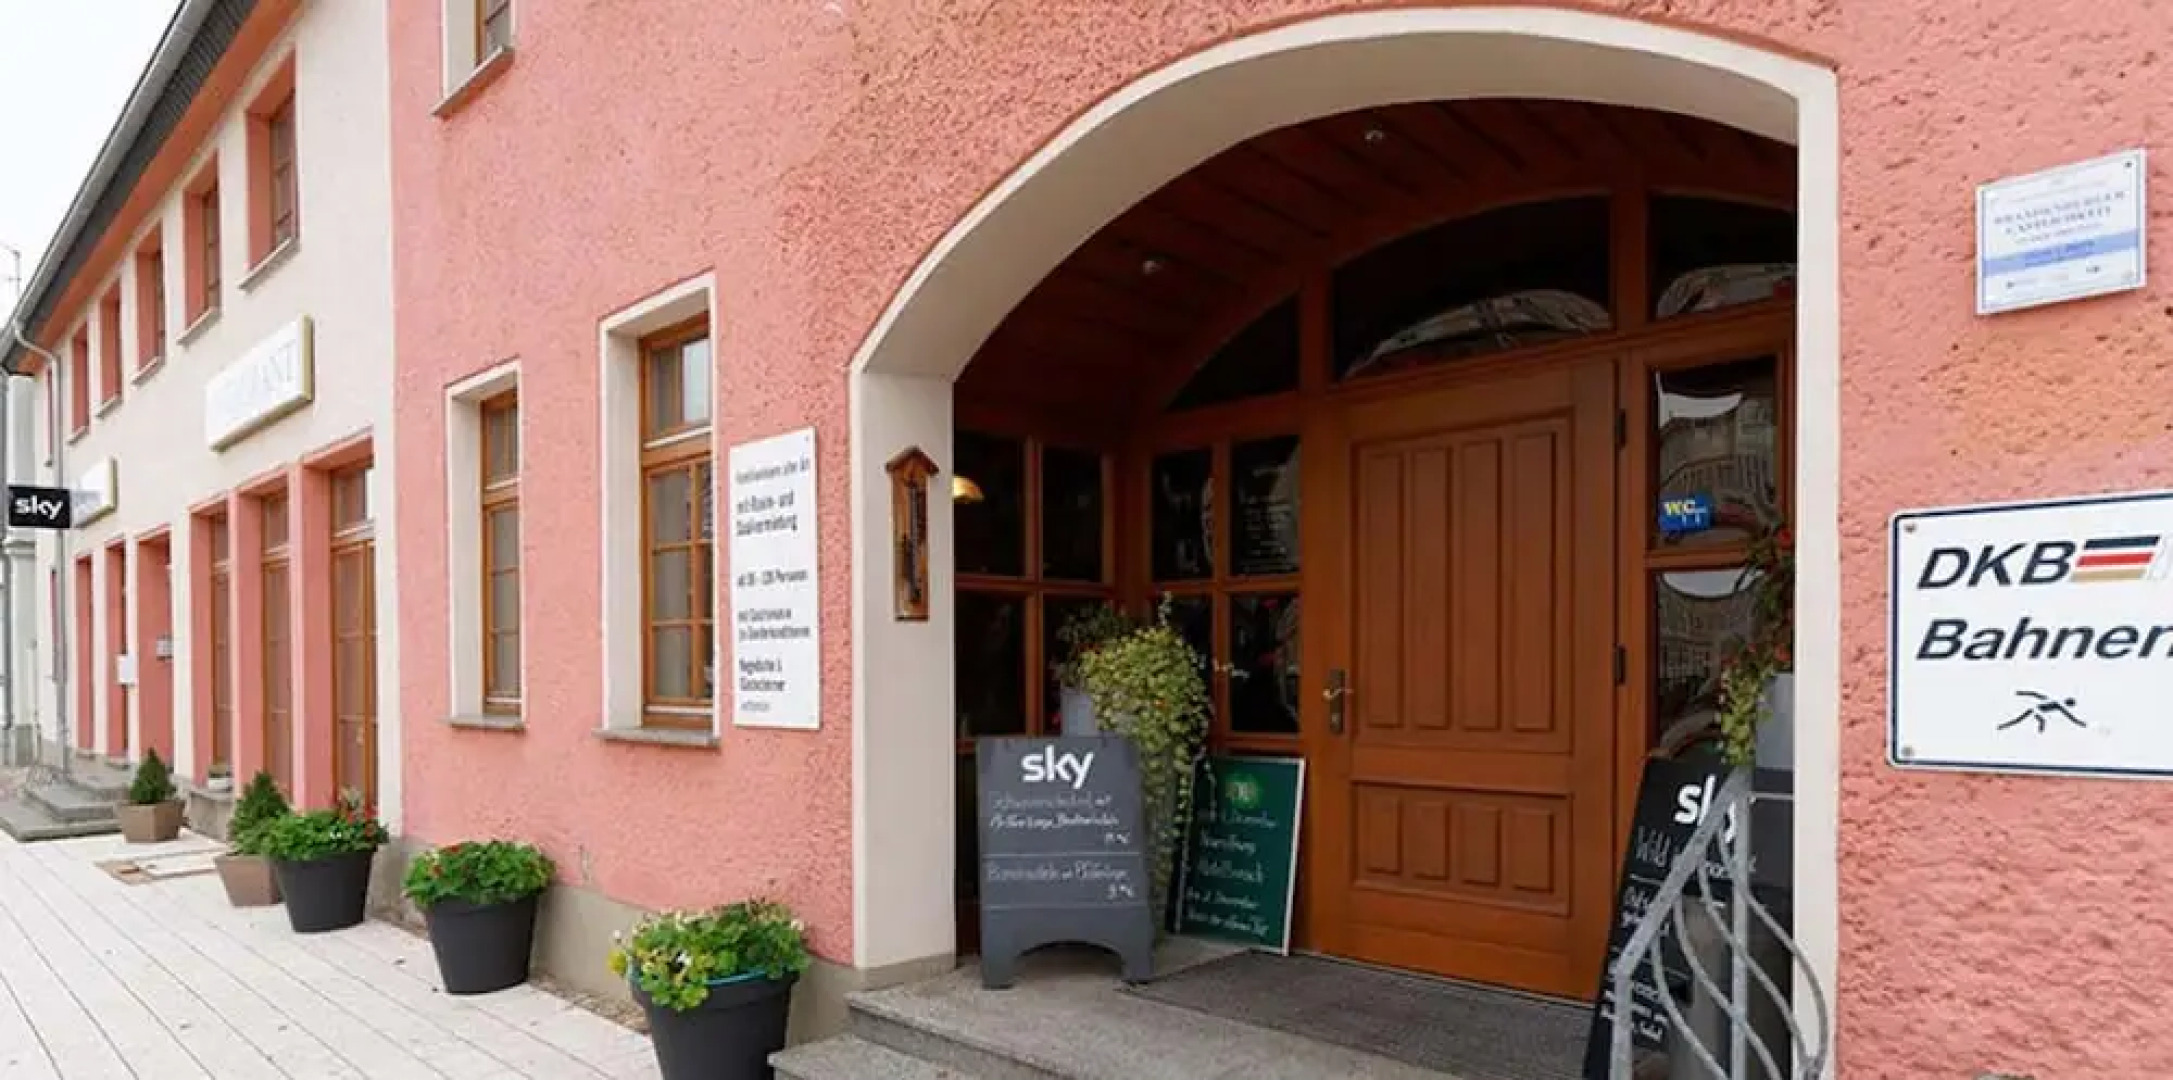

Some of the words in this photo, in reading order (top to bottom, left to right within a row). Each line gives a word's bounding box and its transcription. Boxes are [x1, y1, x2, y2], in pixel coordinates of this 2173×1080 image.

[14, 495, 63, 520] sky
[1915, 540, 2077, 590] DKB
[1915, 616, 2173, 660] Bahnen
[1021, 745, 1095, 789] sky
